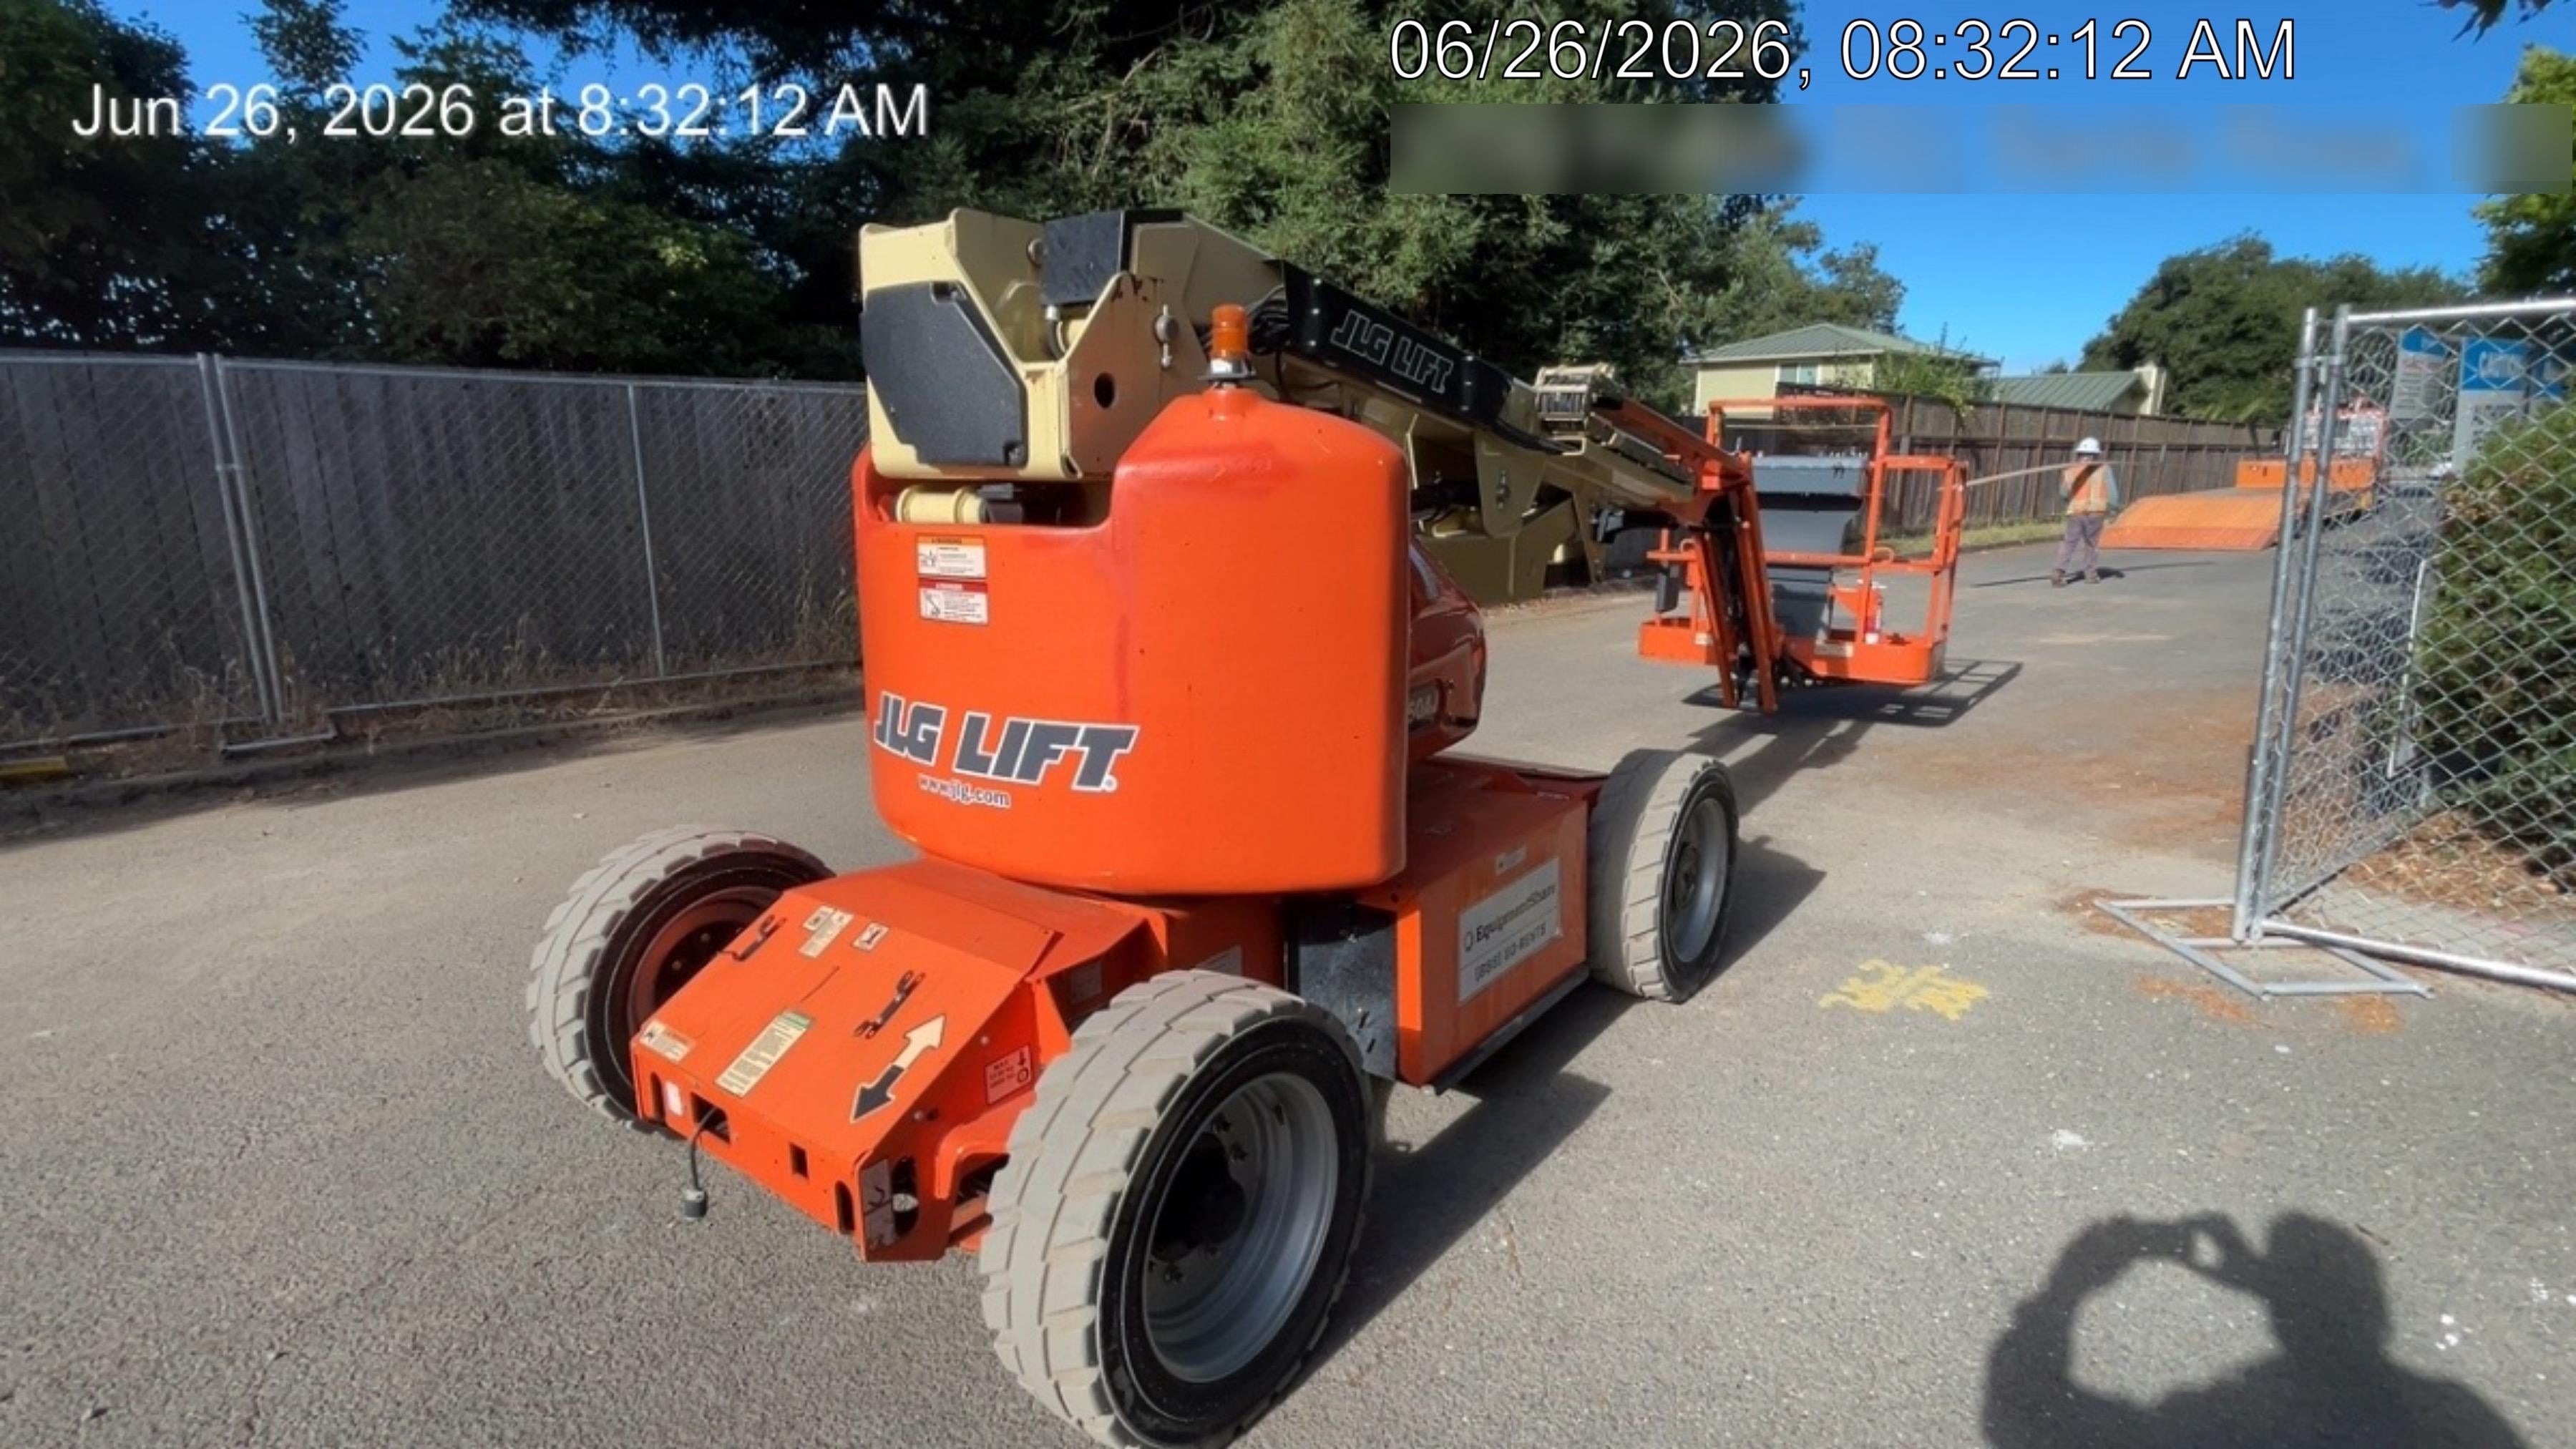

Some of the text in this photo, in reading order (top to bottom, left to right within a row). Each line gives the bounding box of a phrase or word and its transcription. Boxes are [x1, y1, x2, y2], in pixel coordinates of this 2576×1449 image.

[1330, 309, 1454, 394] JLG LIFT
[874, 691, 948, 766] JLG
[918, 774, 1012, 808] www.jlg.com
